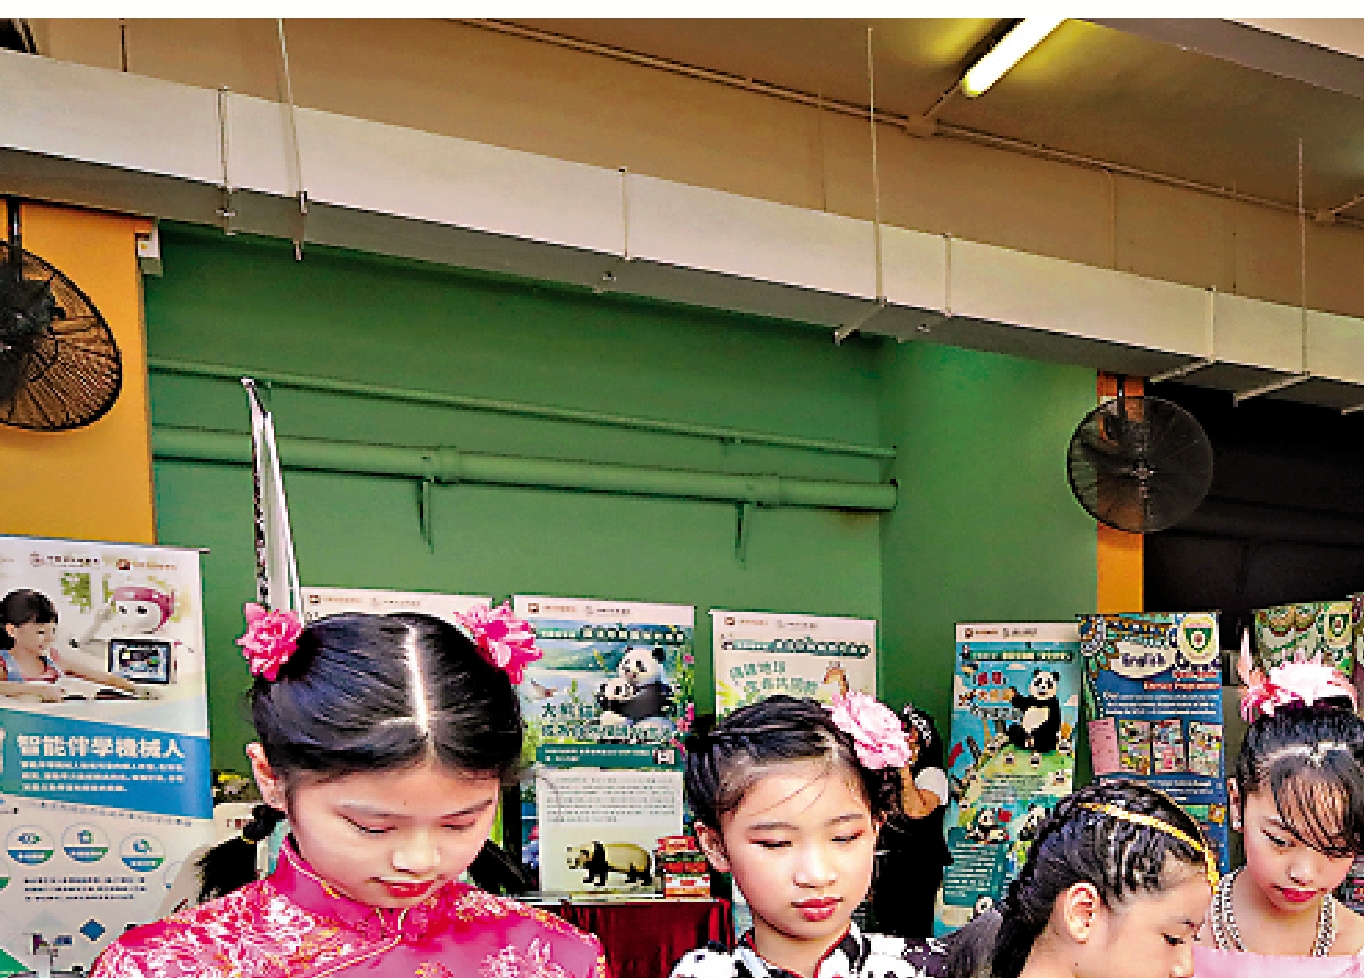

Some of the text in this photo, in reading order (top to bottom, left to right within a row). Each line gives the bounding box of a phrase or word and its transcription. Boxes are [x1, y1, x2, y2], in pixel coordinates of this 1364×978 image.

[1121, 652, 1167, 668] English
[16, 735, 186, 759] 智能伴學機械人
